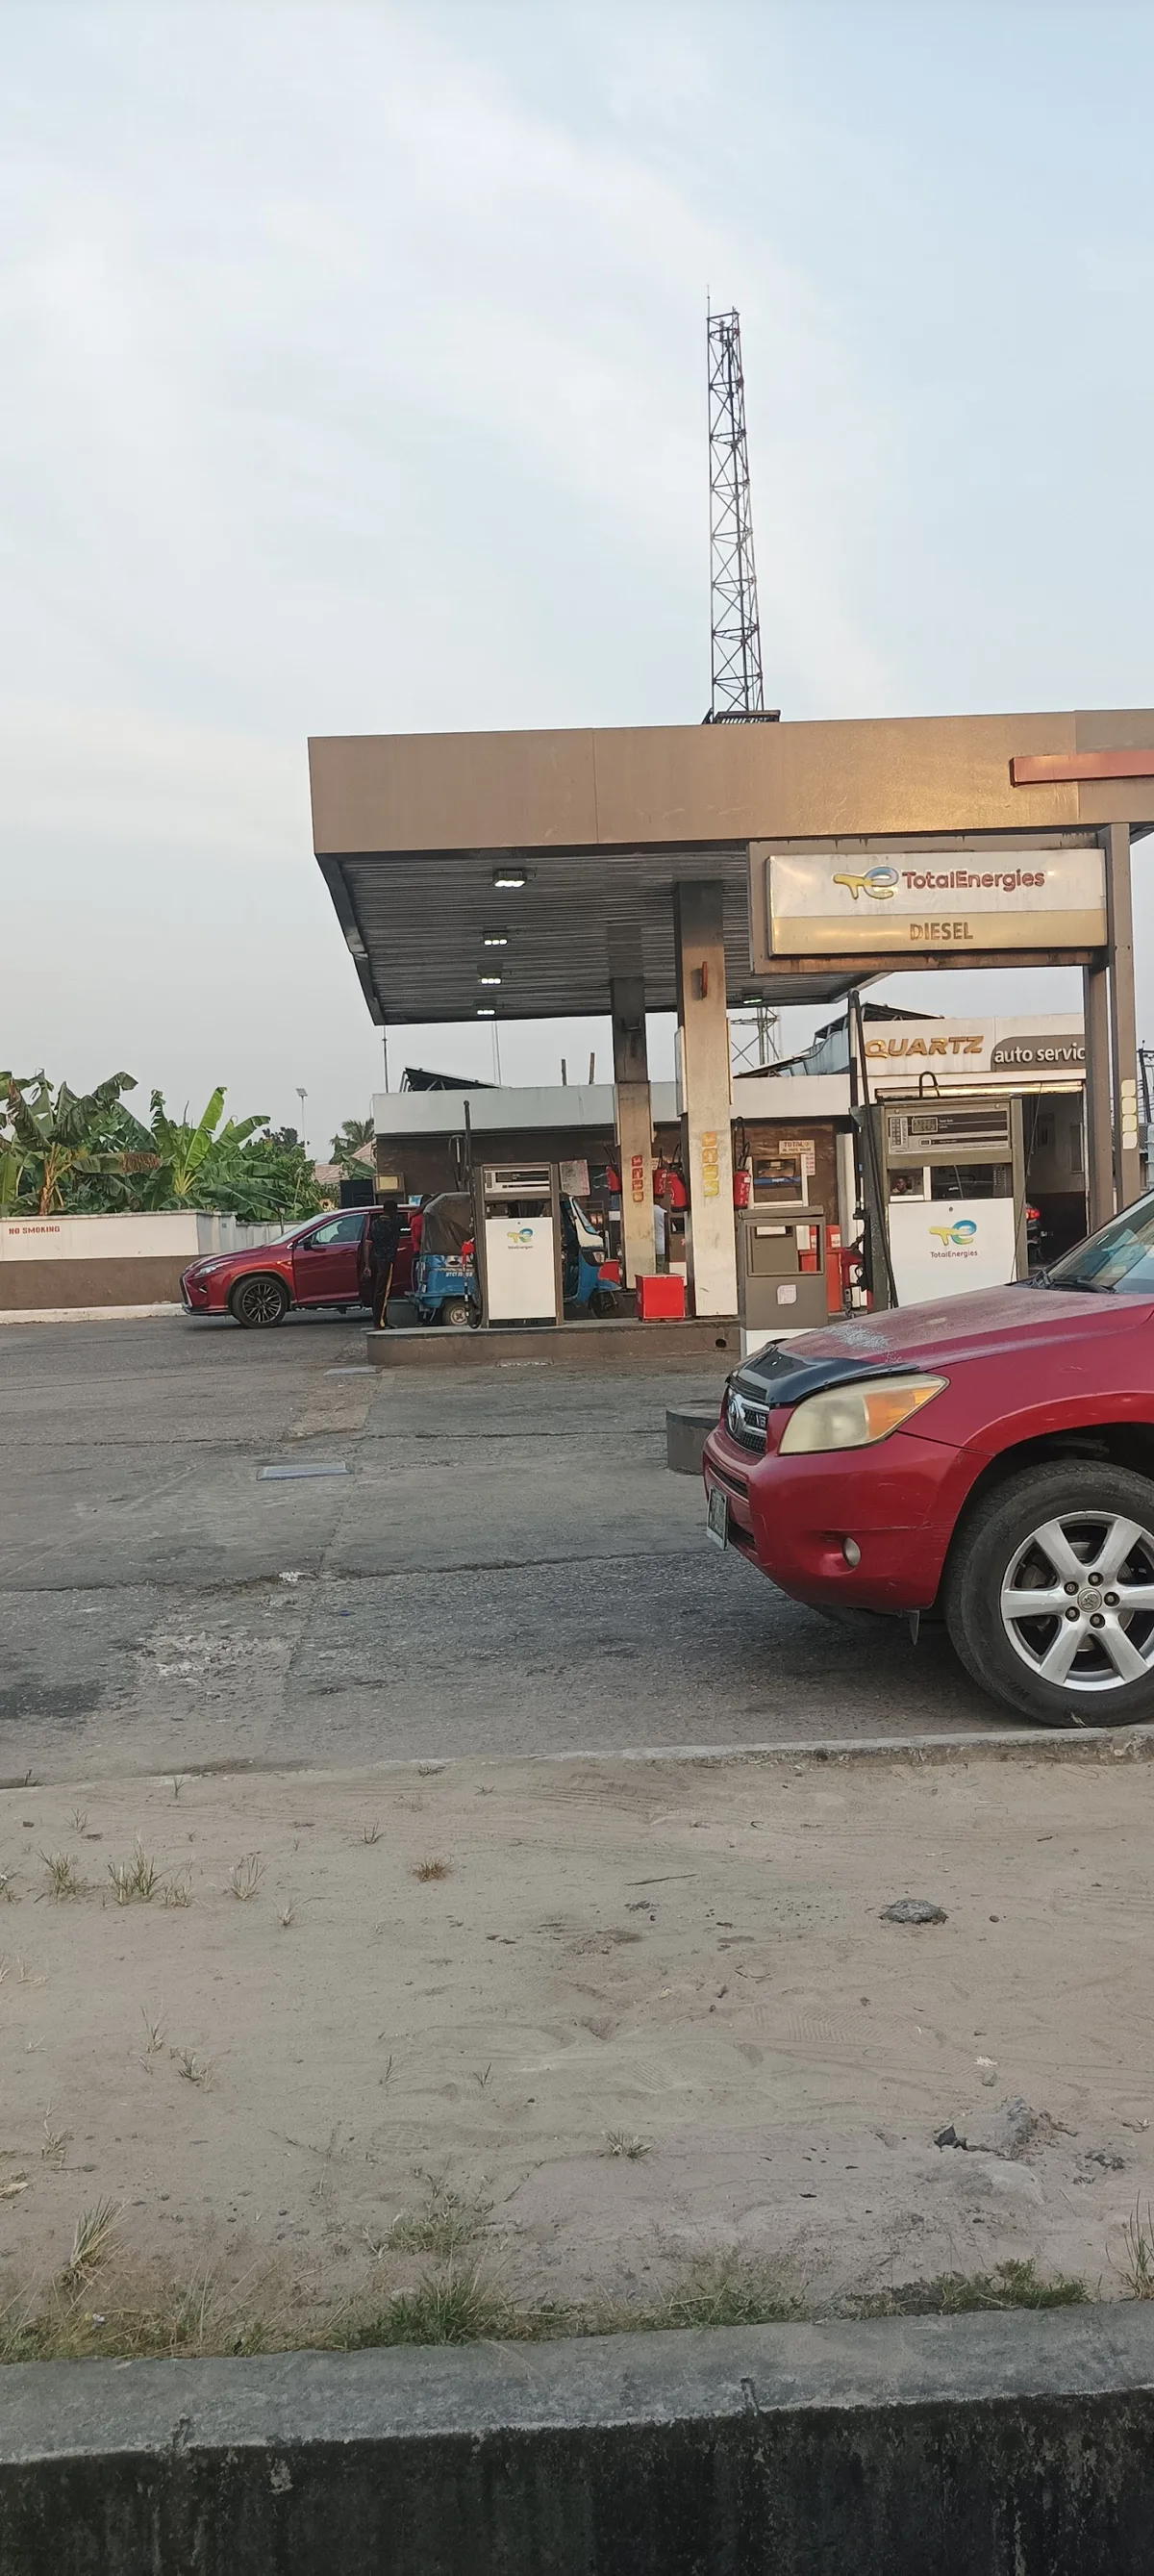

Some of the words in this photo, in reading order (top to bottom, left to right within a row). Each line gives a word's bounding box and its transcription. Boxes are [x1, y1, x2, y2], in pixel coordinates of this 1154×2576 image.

[902, 868, 1044, 892] TotalEnergies
[909, 921, 974, 942] DIESEL
[865, 1035, 985, 1059] QUARTZ
[993, 1046, 1034, 1064] auto
[1036, 1042, 1086, 1062] servic
[22, 1225, 61, 1234] SMOKING
[930, 1250, 978, 1259] TotalEnergies
